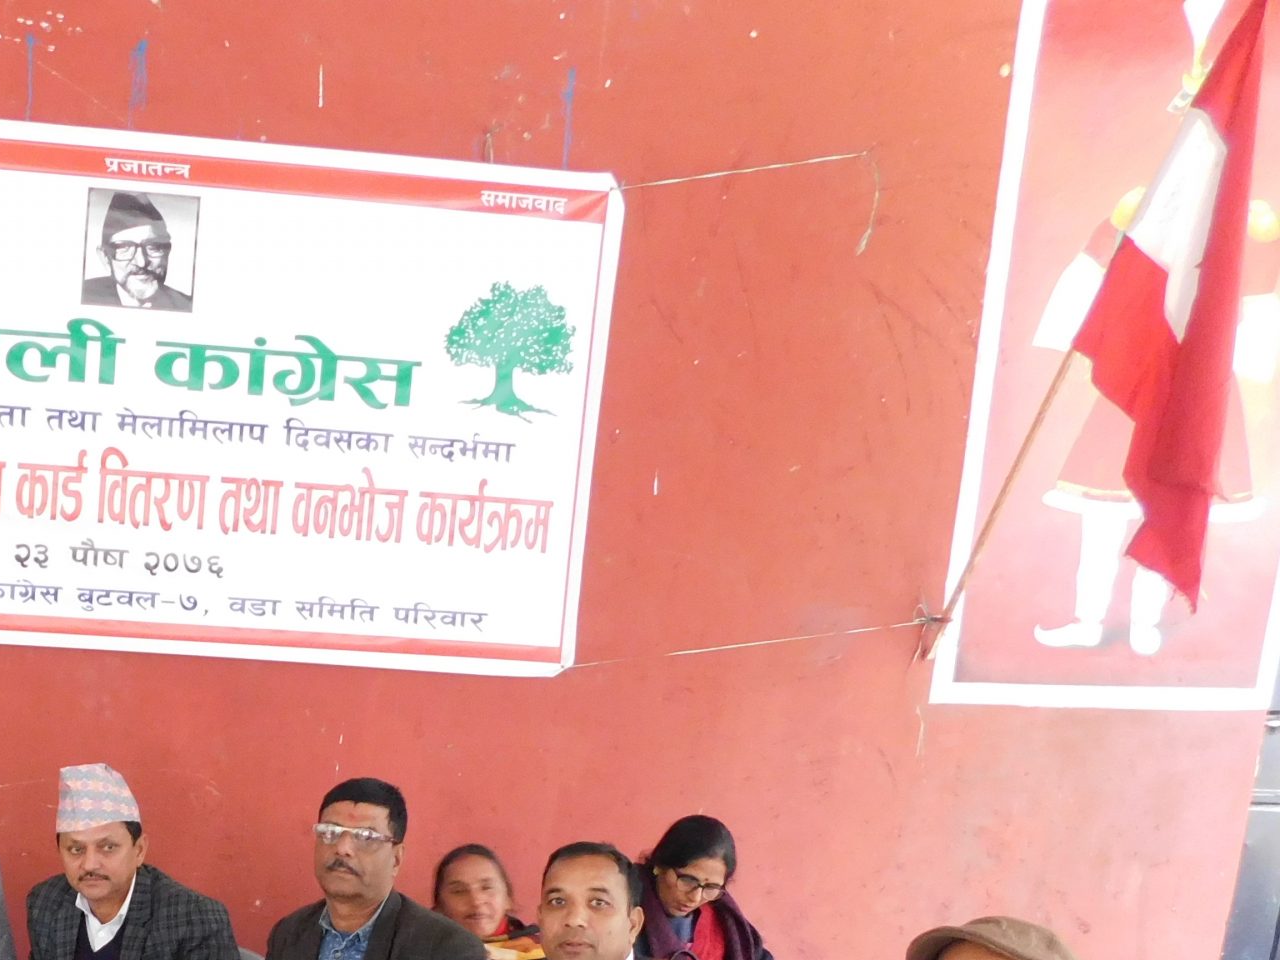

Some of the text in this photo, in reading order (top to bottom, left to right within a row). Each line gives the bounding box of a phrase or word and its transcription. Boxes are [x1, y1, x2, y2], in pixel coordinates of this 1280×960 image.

[104, 157, 190, 179] प्रजातन्त्र
[481, 190, 567, 214] समाजवाद
[154, 335, 422, 409] कांग्रेस
[46, 407, 101, 433] तथा
[116, 408, 269, 444] मेलामिलाप
[284, 418, 393, 453] दिवसका
[408, 434, 516, 462] सन्दर्भमा
[16, 450, 87, 521] कार्ड
[97, 447, 210, 531] वितरण
[219, 476, 283, 535] तथा
[292, 467, 408, 543] वनभोज
[416, 479, 553, 554] कार्यक्रम
[14, 538, 224, 578] २३ पौष २०७६
[228, 597, 281, 616] वडा
[296, 596, 379, 622] समिति
[394, 602, 488, 631] परिवार
